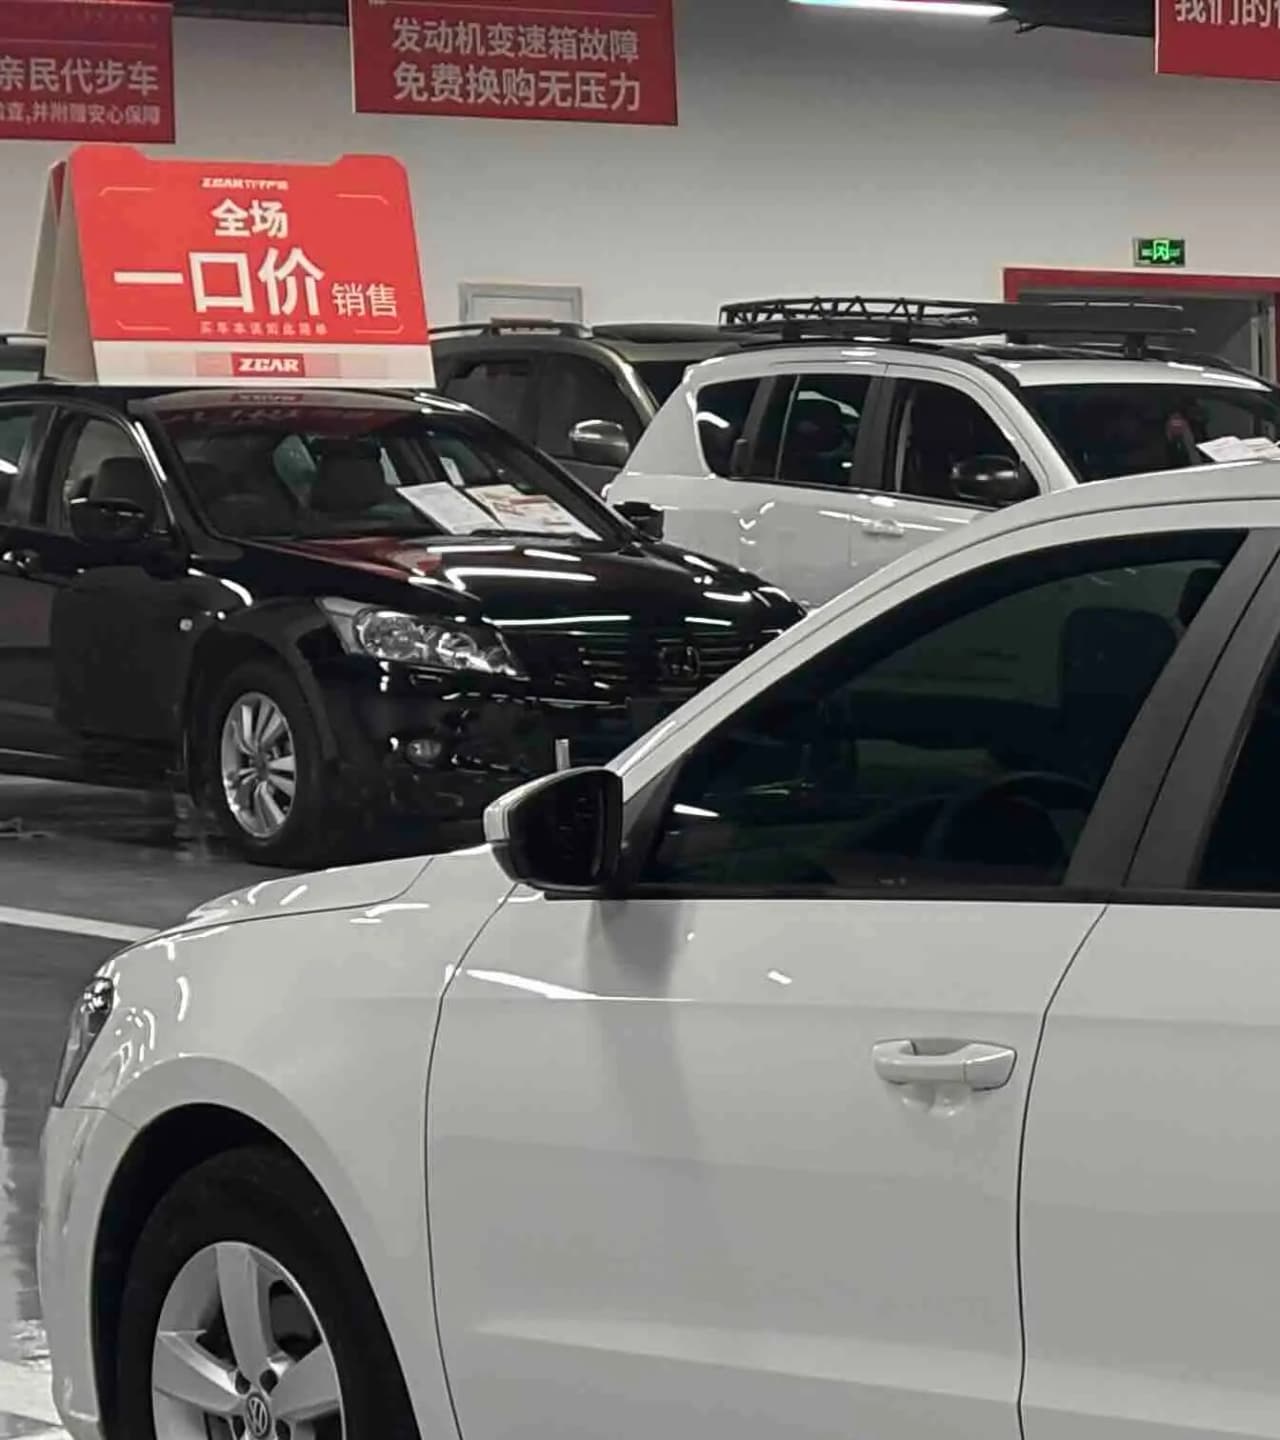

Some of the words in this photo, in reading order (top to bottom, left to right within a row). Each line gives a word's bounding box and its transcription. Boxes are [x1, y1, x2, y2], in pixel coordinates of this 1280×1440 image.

[392, 17, 639, 63] 发动机变速箱故障
[393, 61, 641, 112] 免费换购无压力
[211, 198, 289, 239] 全场
[113, 247, 325, 317] 一口价
[331, 283, 398, 318] 销售
[238, 358, 299, 373] ZCAR
